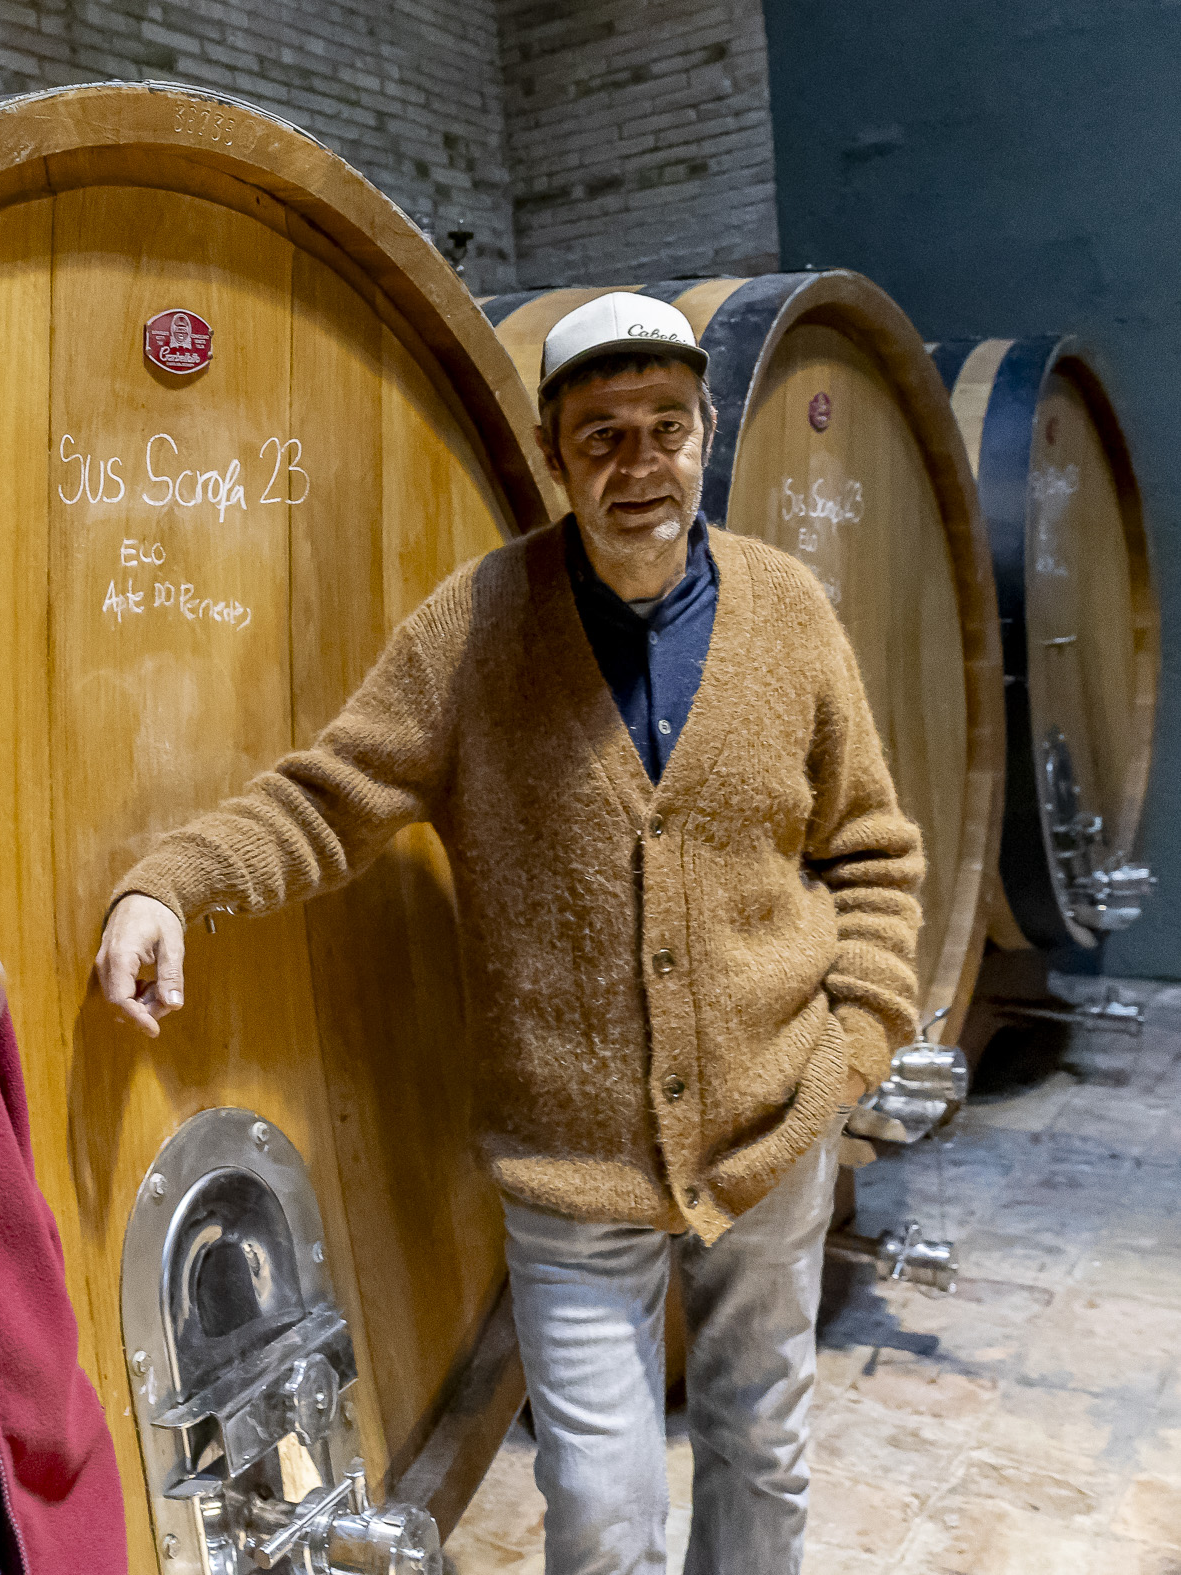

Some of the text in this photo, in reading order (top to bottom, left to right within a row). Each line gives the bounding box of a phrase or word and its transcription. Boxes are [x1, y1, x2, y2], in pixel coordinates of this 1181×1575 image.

[58, 433, 310, 523] Sus Scrofa 23
